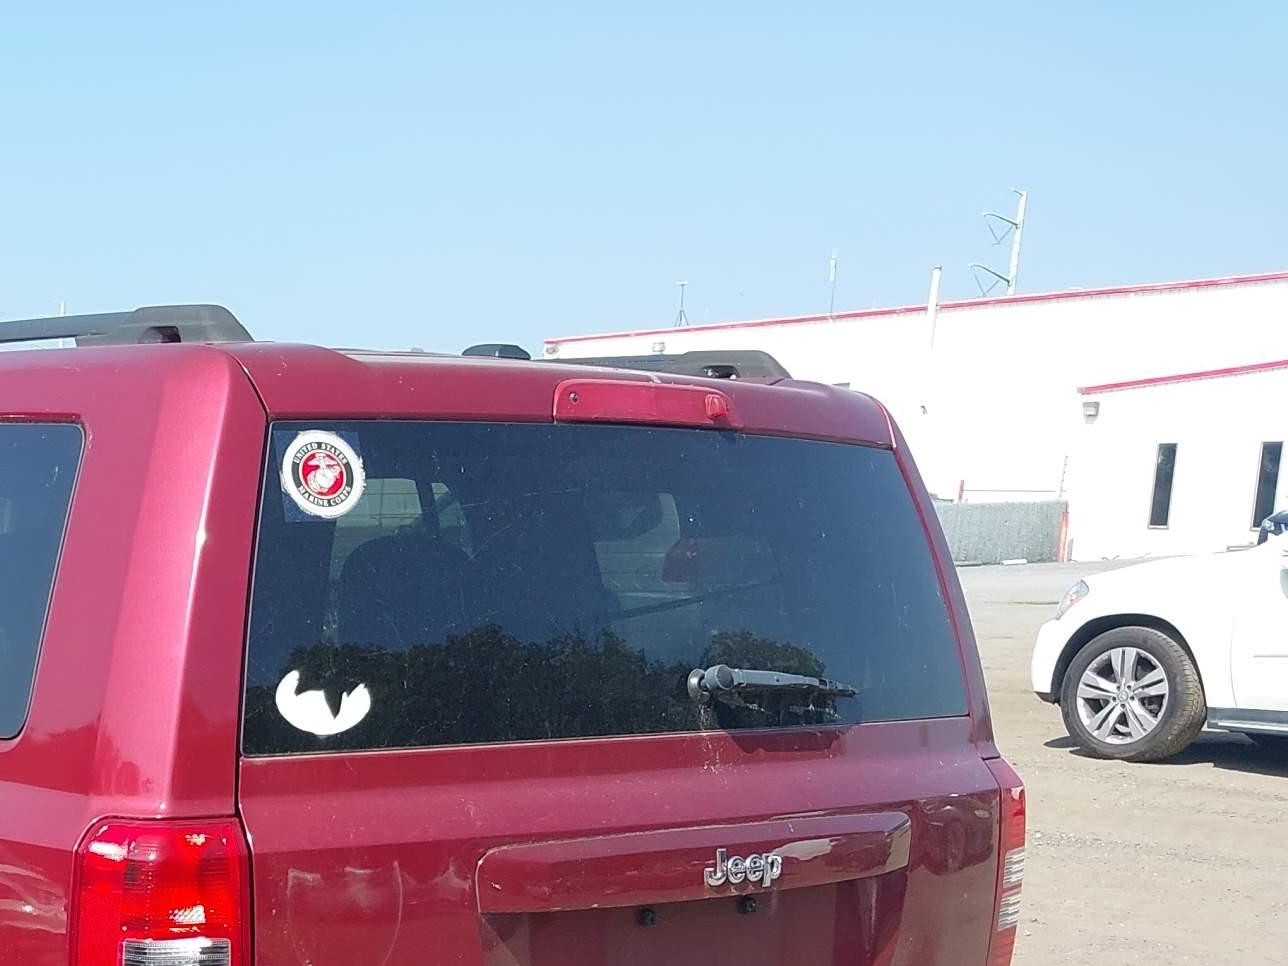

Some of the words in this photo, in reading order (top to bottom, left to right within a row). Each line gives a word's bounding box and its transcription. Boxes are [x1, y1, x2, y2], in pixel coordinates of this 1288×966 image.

[293, 442, 318, 464] UNITED
[321, 442, 348, 464] STATES
[298, 485, 329, 507] MARINE
[331, 486, 351, 507] CORPS
[704, 848, 782, 888] Jeep
